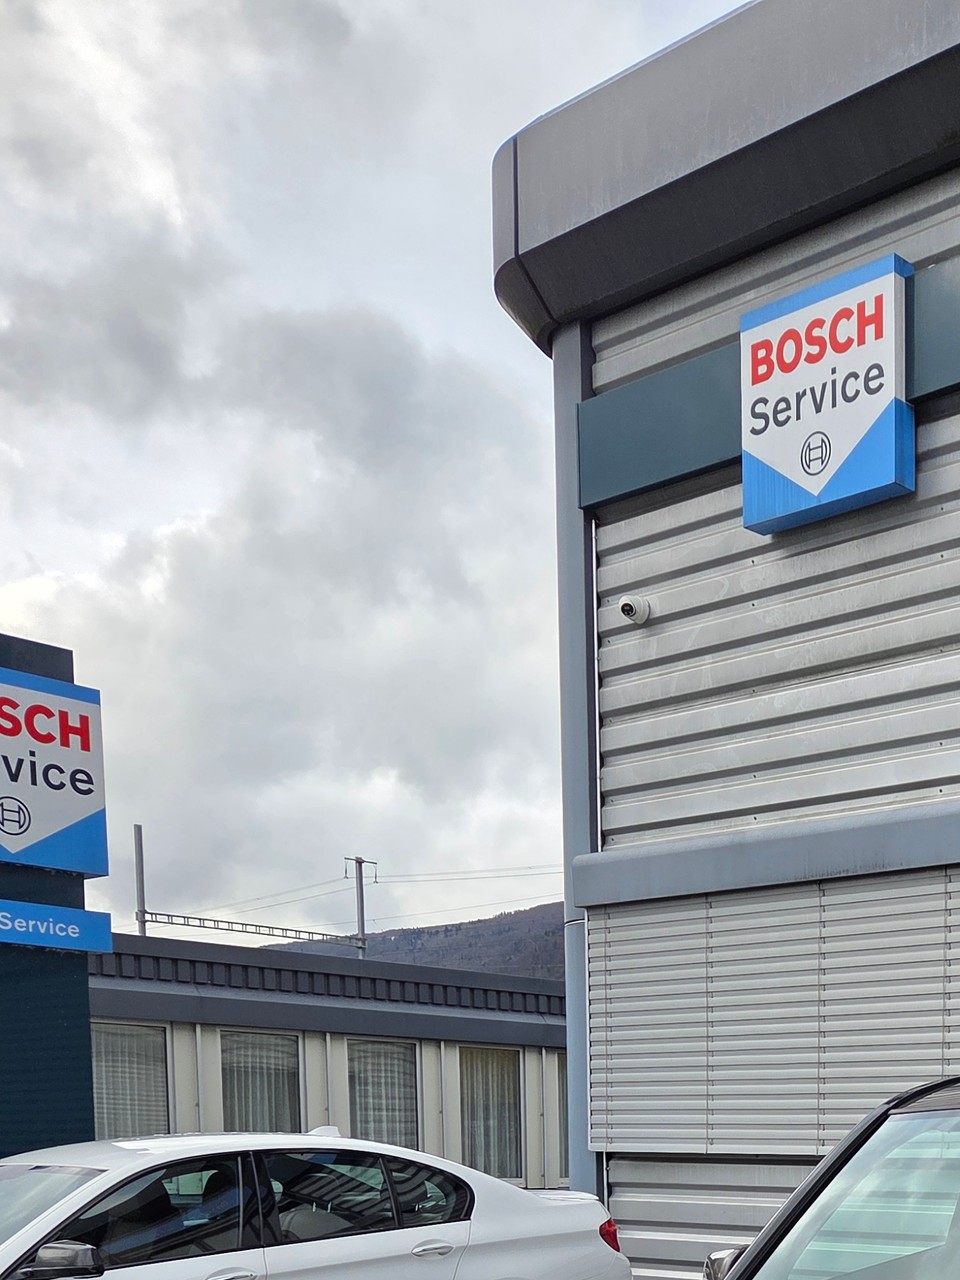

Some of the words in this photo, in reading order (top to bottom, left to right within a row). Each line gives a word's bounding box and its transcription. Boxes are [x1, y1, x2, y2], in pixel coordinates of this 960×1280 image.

[751, 293, 884, 386] BOSCH
[749, 362, 885, 436] Service
[1, 750, 94, 796] vice
[0, 912, 80, 937] Service
